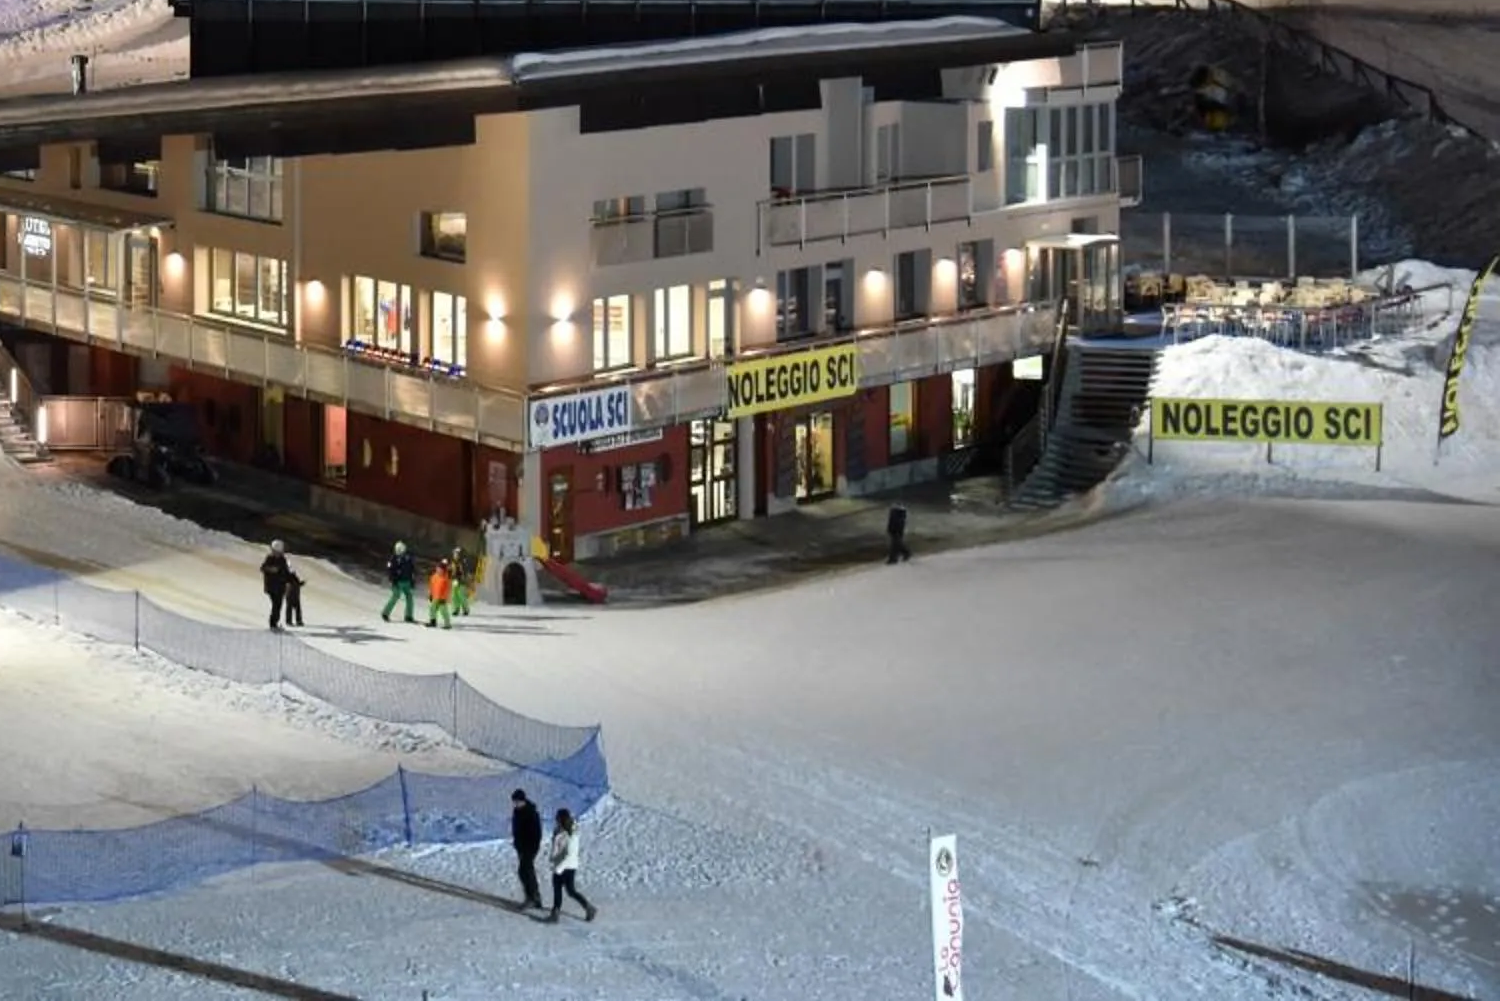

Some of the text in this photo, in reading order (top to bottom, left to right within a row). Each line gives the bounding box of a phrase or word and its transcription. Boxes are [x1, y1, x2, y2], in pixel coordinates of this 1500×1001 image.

[727, 352, 855, 409] NOLEGGIO SCI
[552, 391, 629, 439] SCUOLA SCI
[1161, 401, 1371, 440] NOLEGGIO SCI
